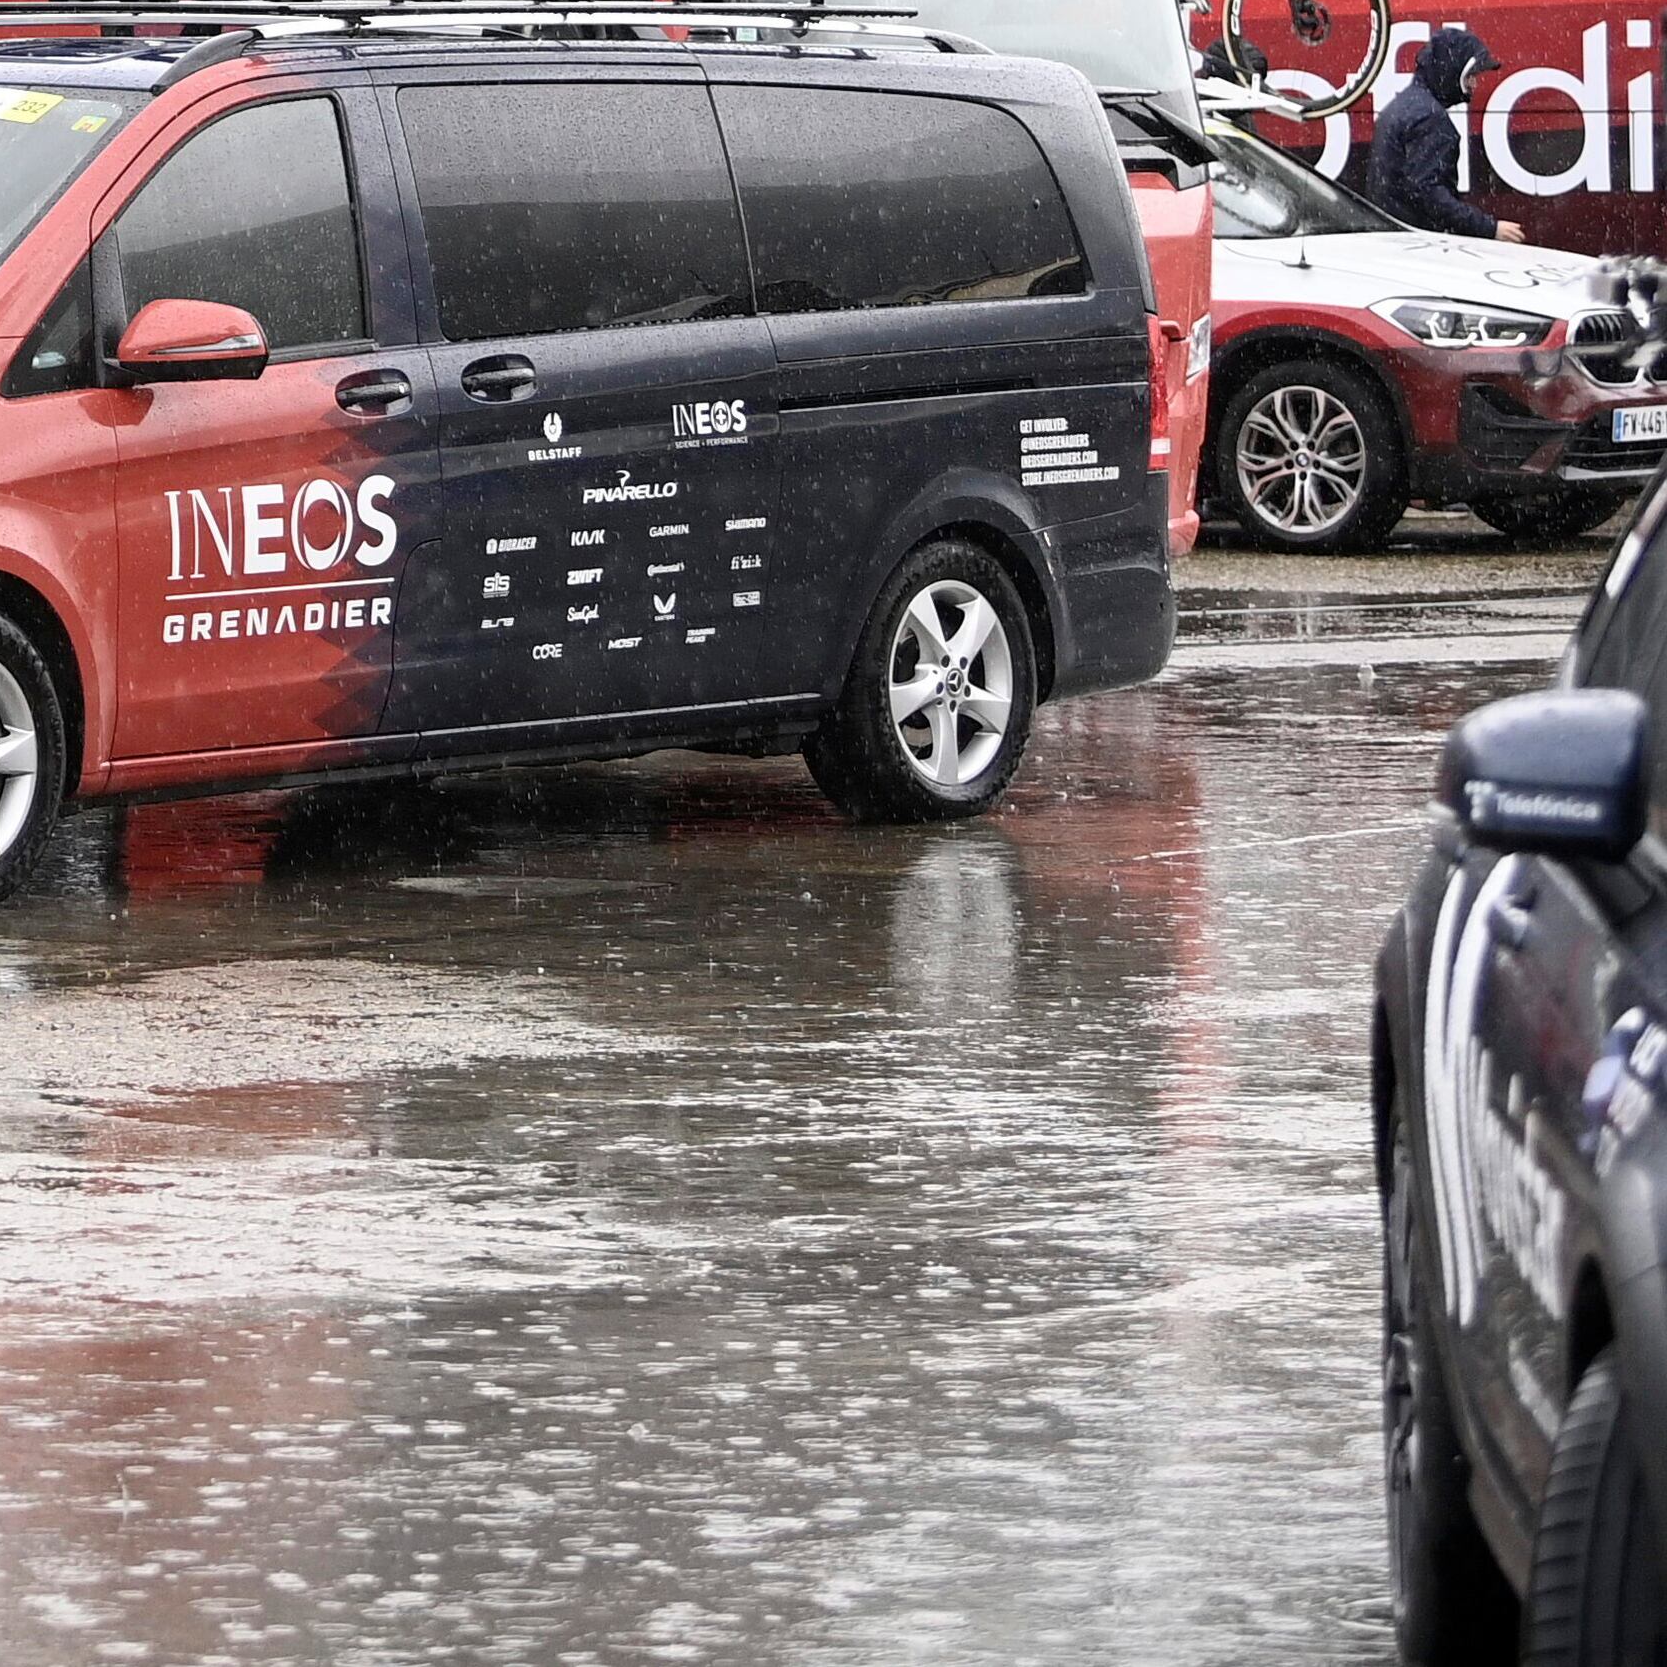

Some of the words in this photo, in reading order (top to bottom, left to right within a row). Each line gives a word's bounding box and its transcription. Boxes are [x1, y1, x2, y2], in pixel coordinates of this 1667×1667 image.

[11, 98, 48, 115] 232
[672, 399, 747, 437] INEOS
[528, 446, 583, 462] BELSTAFF
[583, 481, 678, 505] PINARELLO
[164, 474, 398, 581] INEOS
[649, 523, 690, 538] GARMIN
[571, 529, 606, 547] KASK
[567, 568, 604, 586] ZWIFT
[163, 597, 393, 644] GRENADIER
[532, 643, 564, 660] CORE
[608, 637, 644, 650] MOST
[1496, 792, 1603, 822] Telefónica
